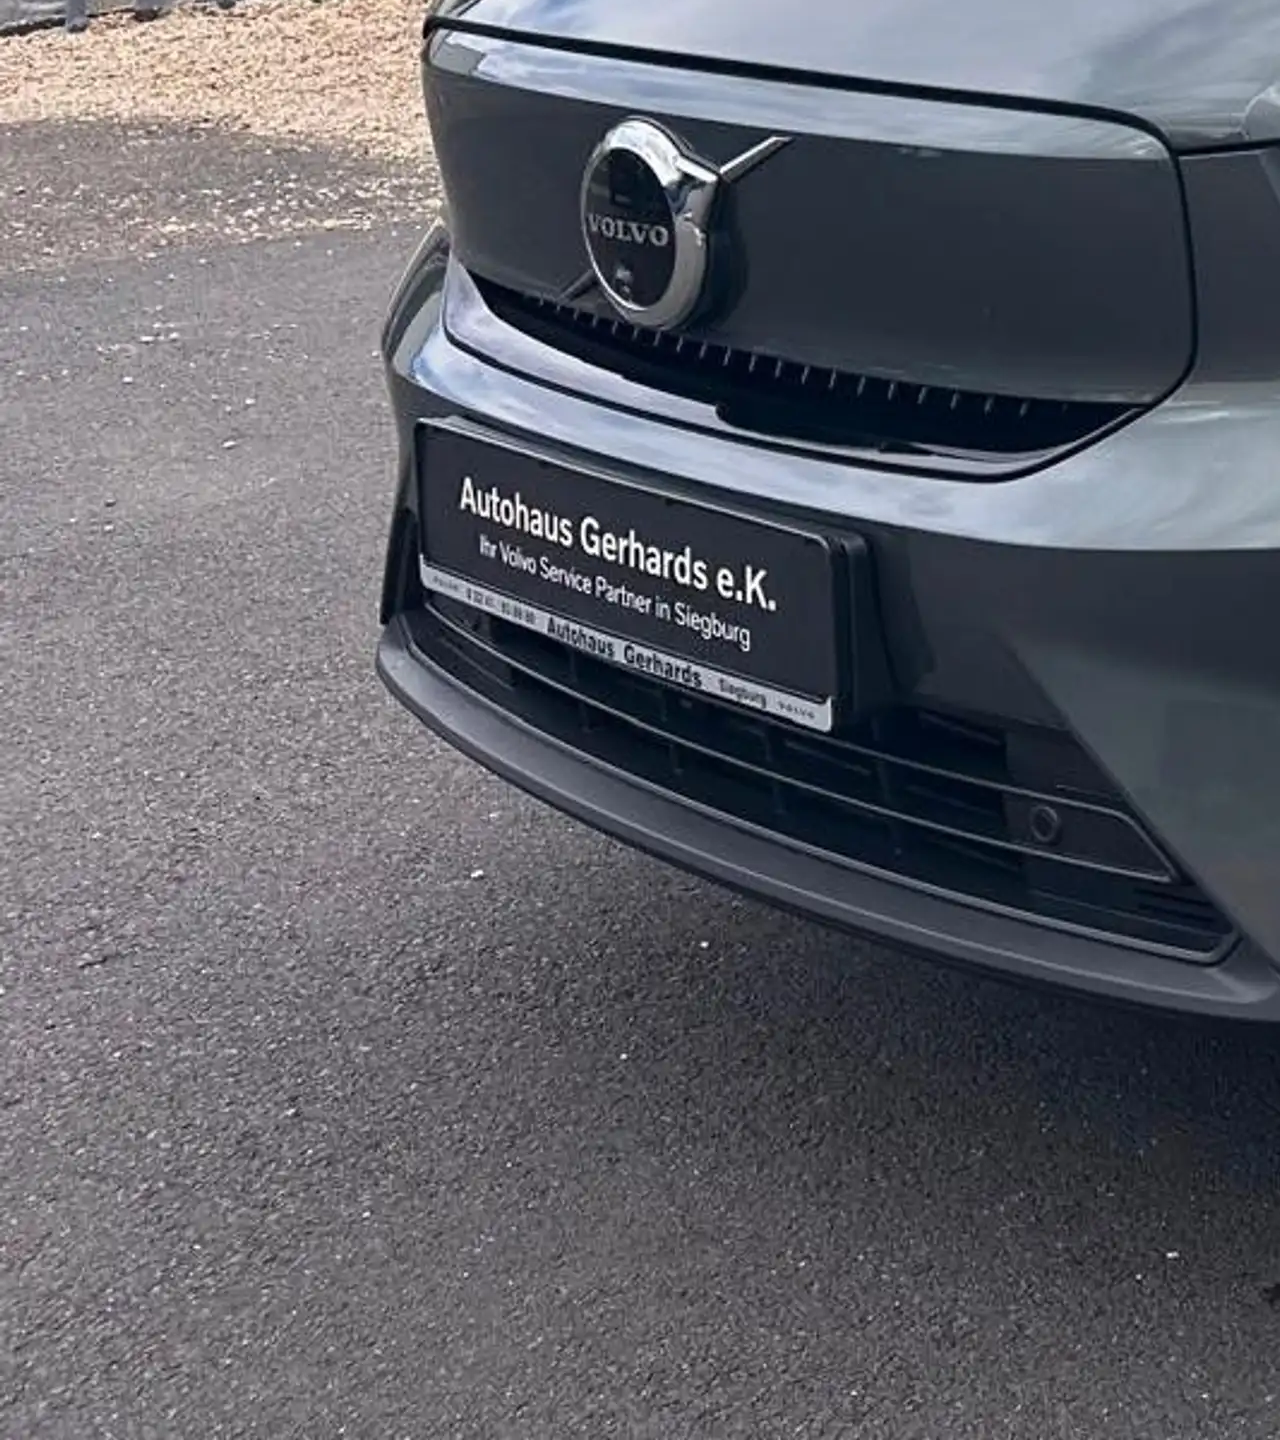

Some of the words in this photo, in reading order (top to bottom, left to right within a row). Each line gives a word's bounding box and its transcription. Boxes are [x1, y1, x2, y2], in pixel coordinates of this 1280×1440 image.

[587, 213, 669, 247] VOLVO
[459, 475, 574, 548] Autohaus
[579, 515, 709, 591] Gerhards
[715, 564, 777, 612] e.K.
[479, 533, 498, 559] Ihr
[499, 539, 537, 575] Volvo
[539, 556, 592, 595] Service
[594, 575, 652, 615] Partner
[654, 595, 672, 622] in
[674, 601, 751, 653] Siegburg
[546, 616, 616, 658] Autohaus
[622, 643, 703, 687] Gerhards
